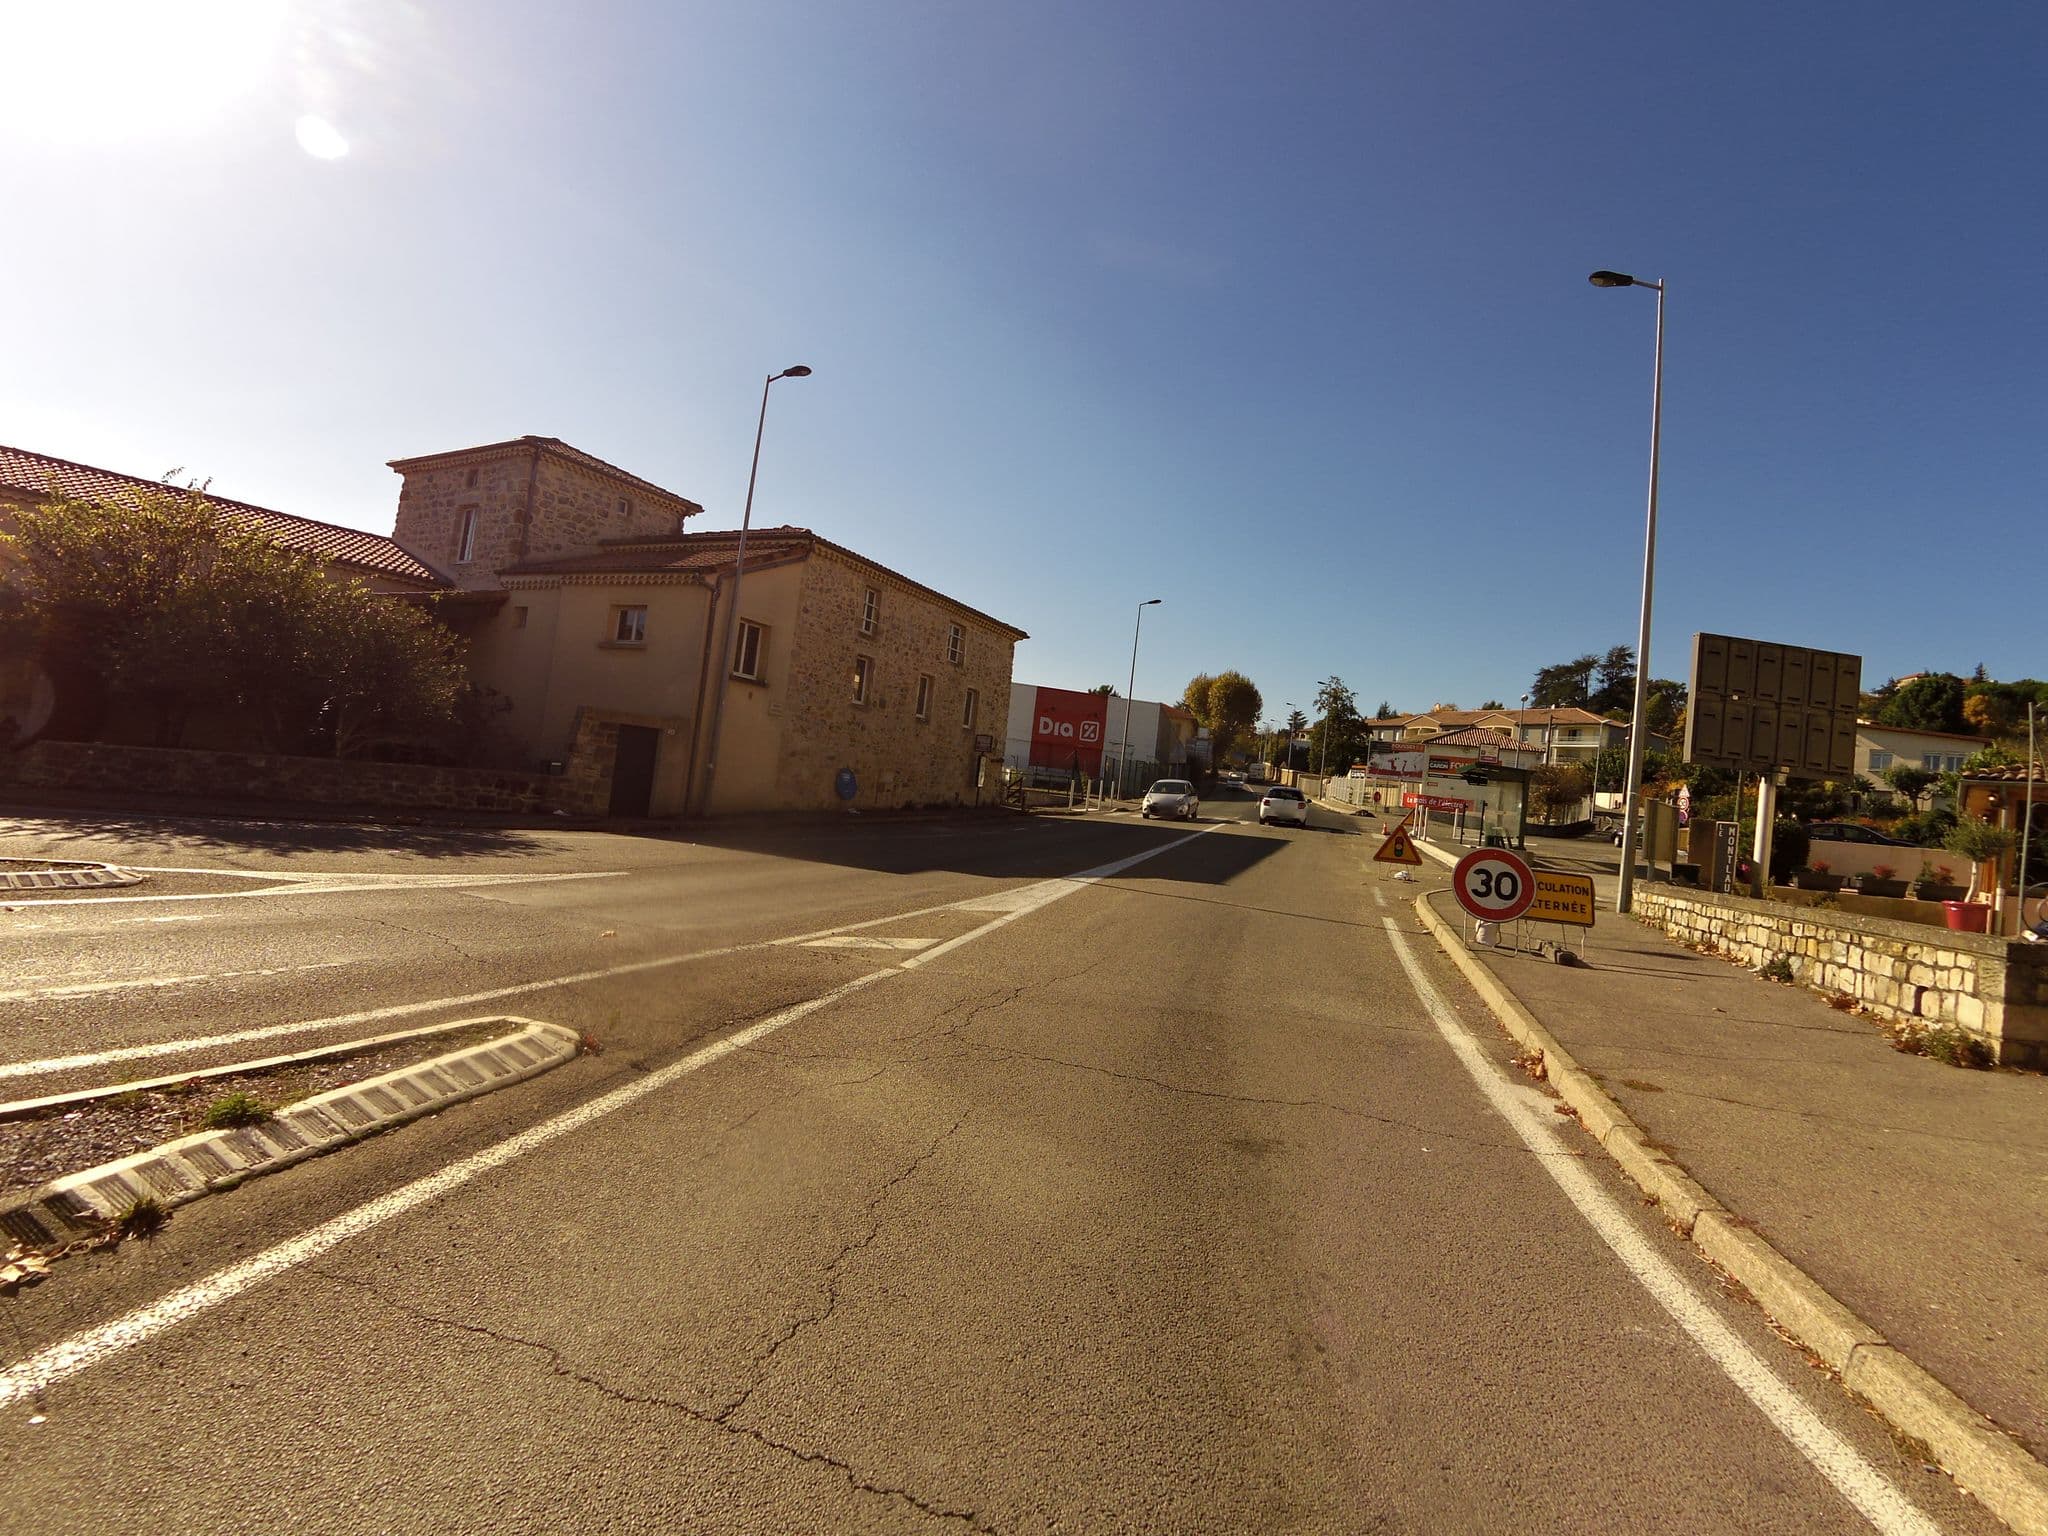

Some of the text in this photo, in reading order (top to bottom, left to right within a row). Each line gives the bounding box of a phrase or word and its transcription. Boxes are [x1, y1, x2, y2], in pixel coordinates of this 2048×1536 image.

[1724, 826, 1736, 893] MONTLAU
[1471, 868, 1518, 901] 30
[1537, 881, 1589, 896] CULATION
[1531, 898, 1587, 914] LTERNÉE
